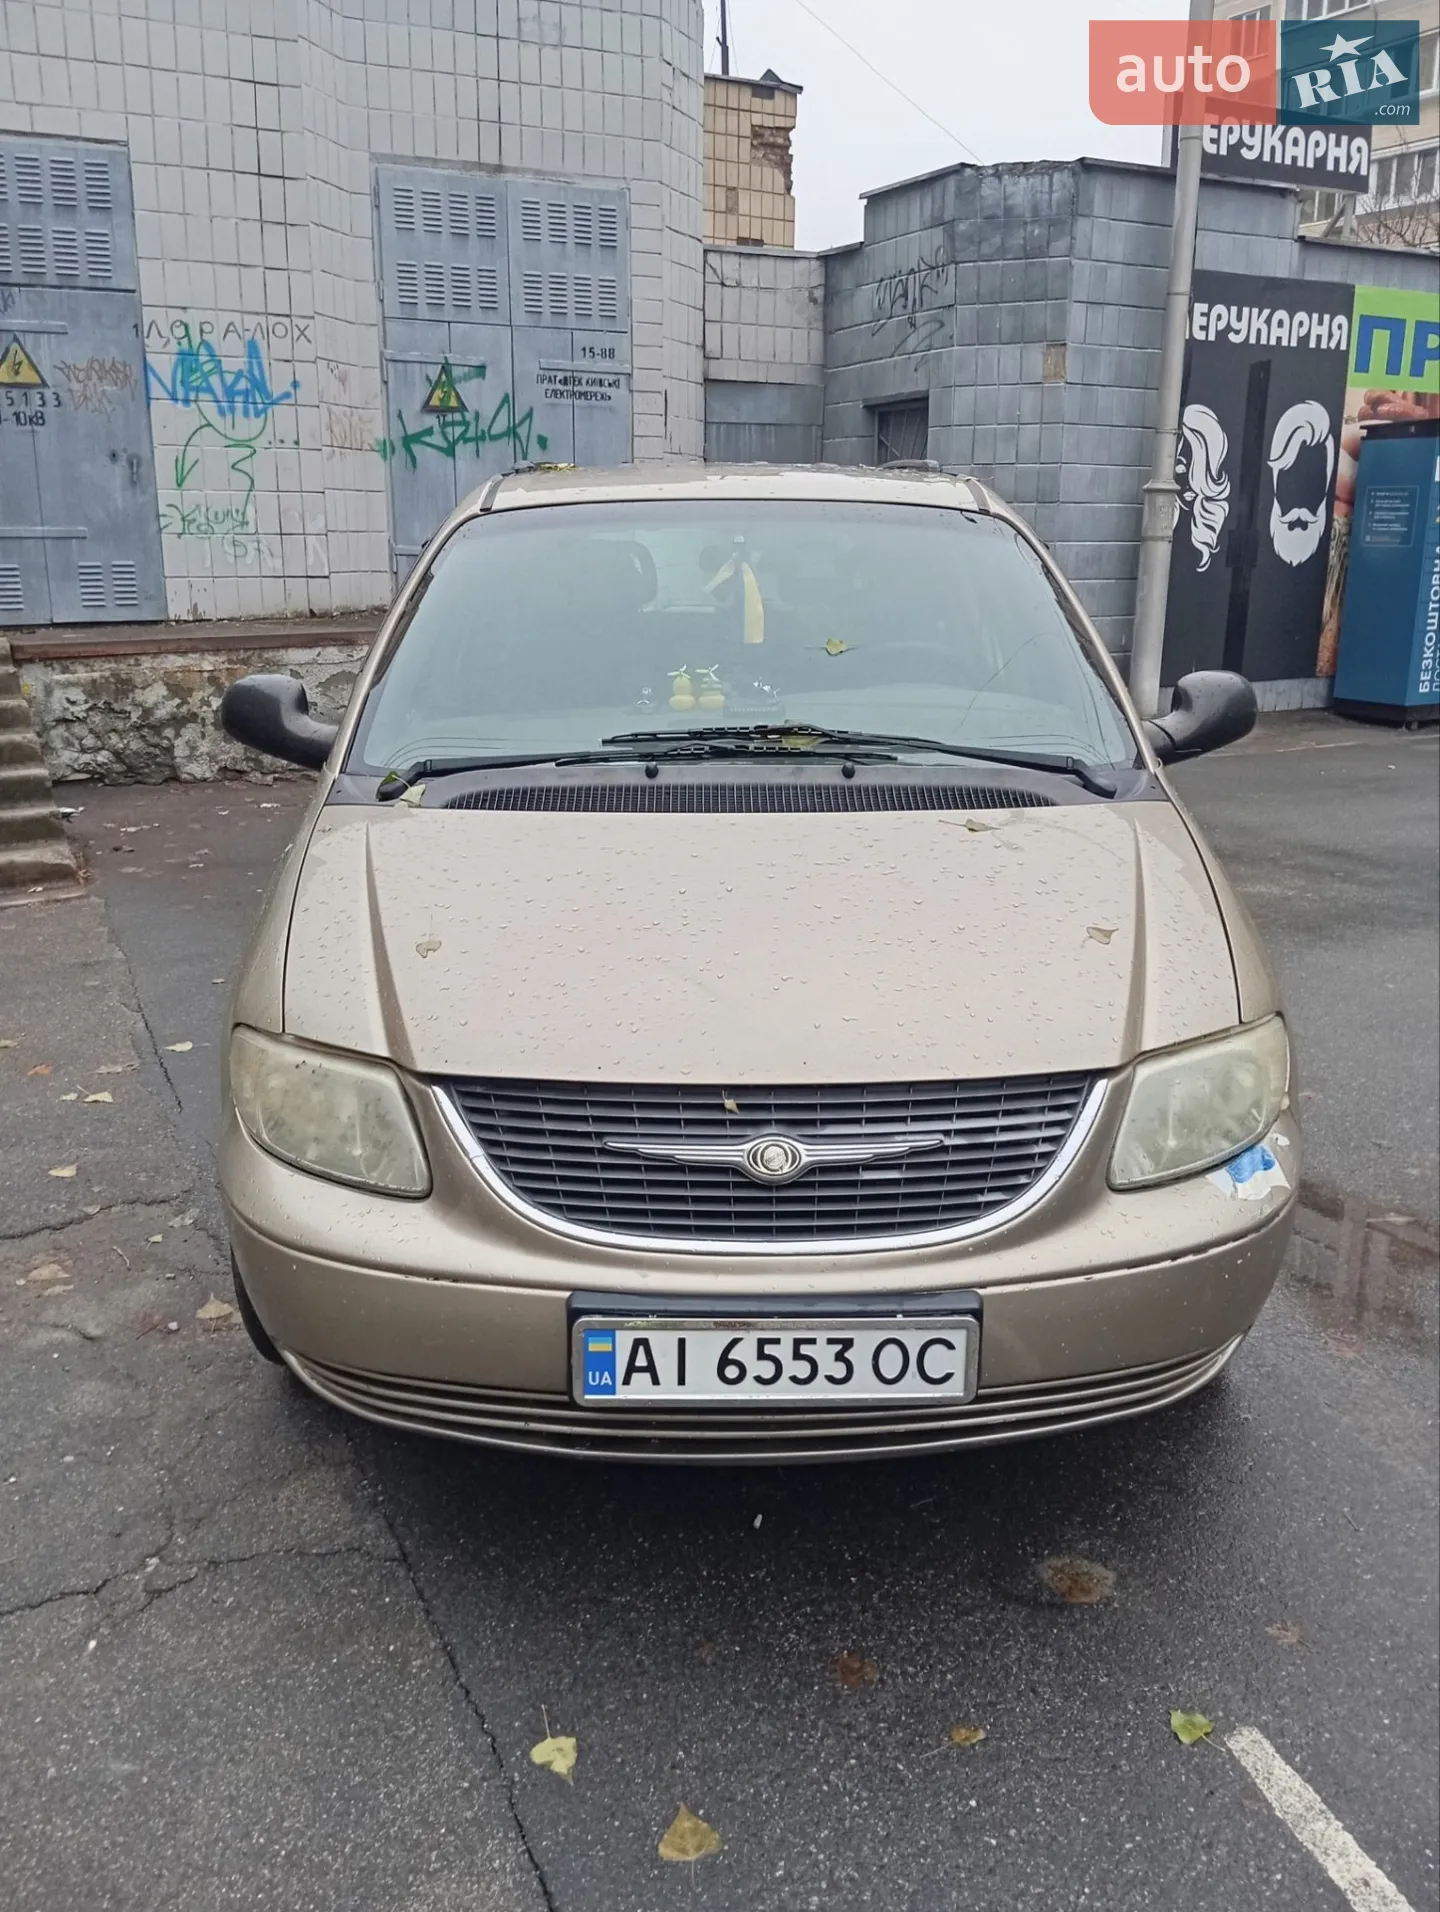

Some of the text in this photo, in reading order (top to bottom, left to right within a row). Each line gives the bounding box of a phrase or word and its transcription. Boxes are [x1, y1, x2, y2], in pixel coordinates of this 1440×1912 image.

[1179, 113, 1369, 176] ЕРУКАРНЯ
[1185, 302, 1349, 351] ЕРУКАРНЯ
[588, 1371, 613, 1386] UA
[621, 1336, 957, 1386] AI 6553 OC
